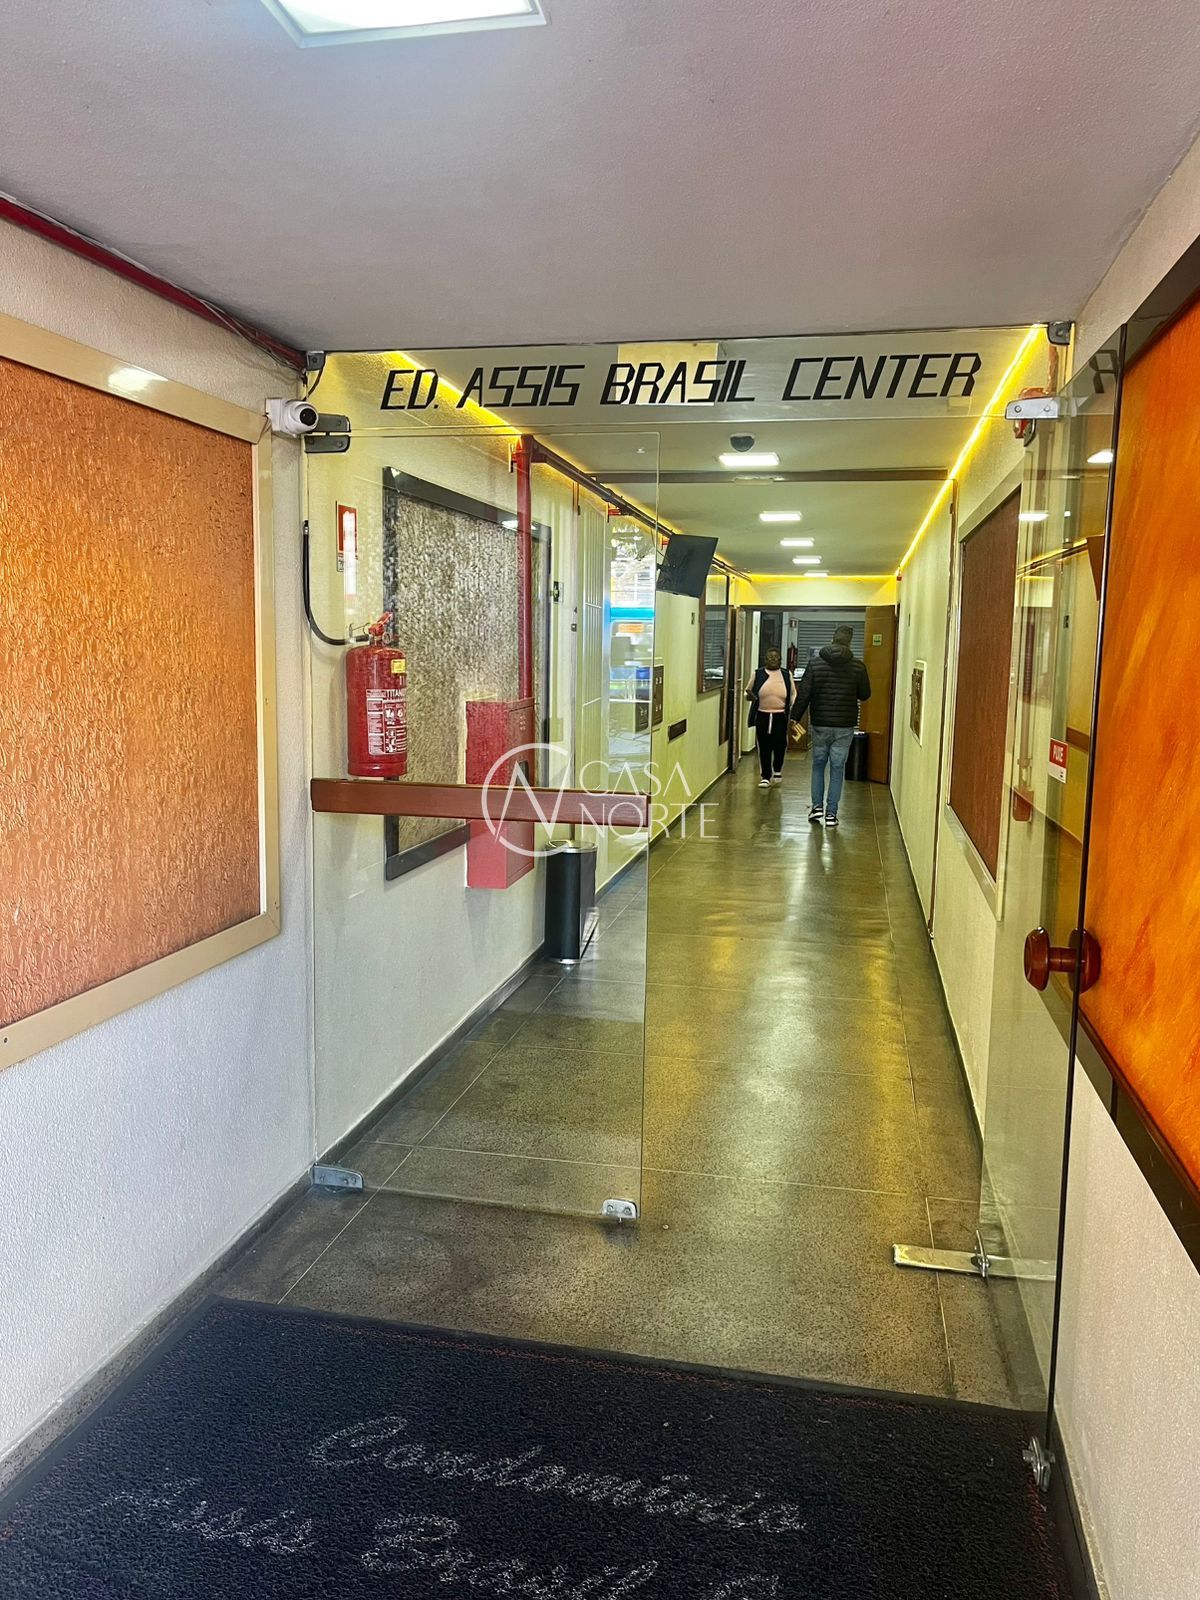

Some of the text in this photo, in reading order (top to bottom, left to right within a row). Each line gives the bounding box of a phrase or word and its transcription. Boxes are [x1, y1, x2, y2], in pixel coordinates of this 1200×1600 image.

[380, 352, 982, 410] ED. ASSIS BRASIL CENTER
